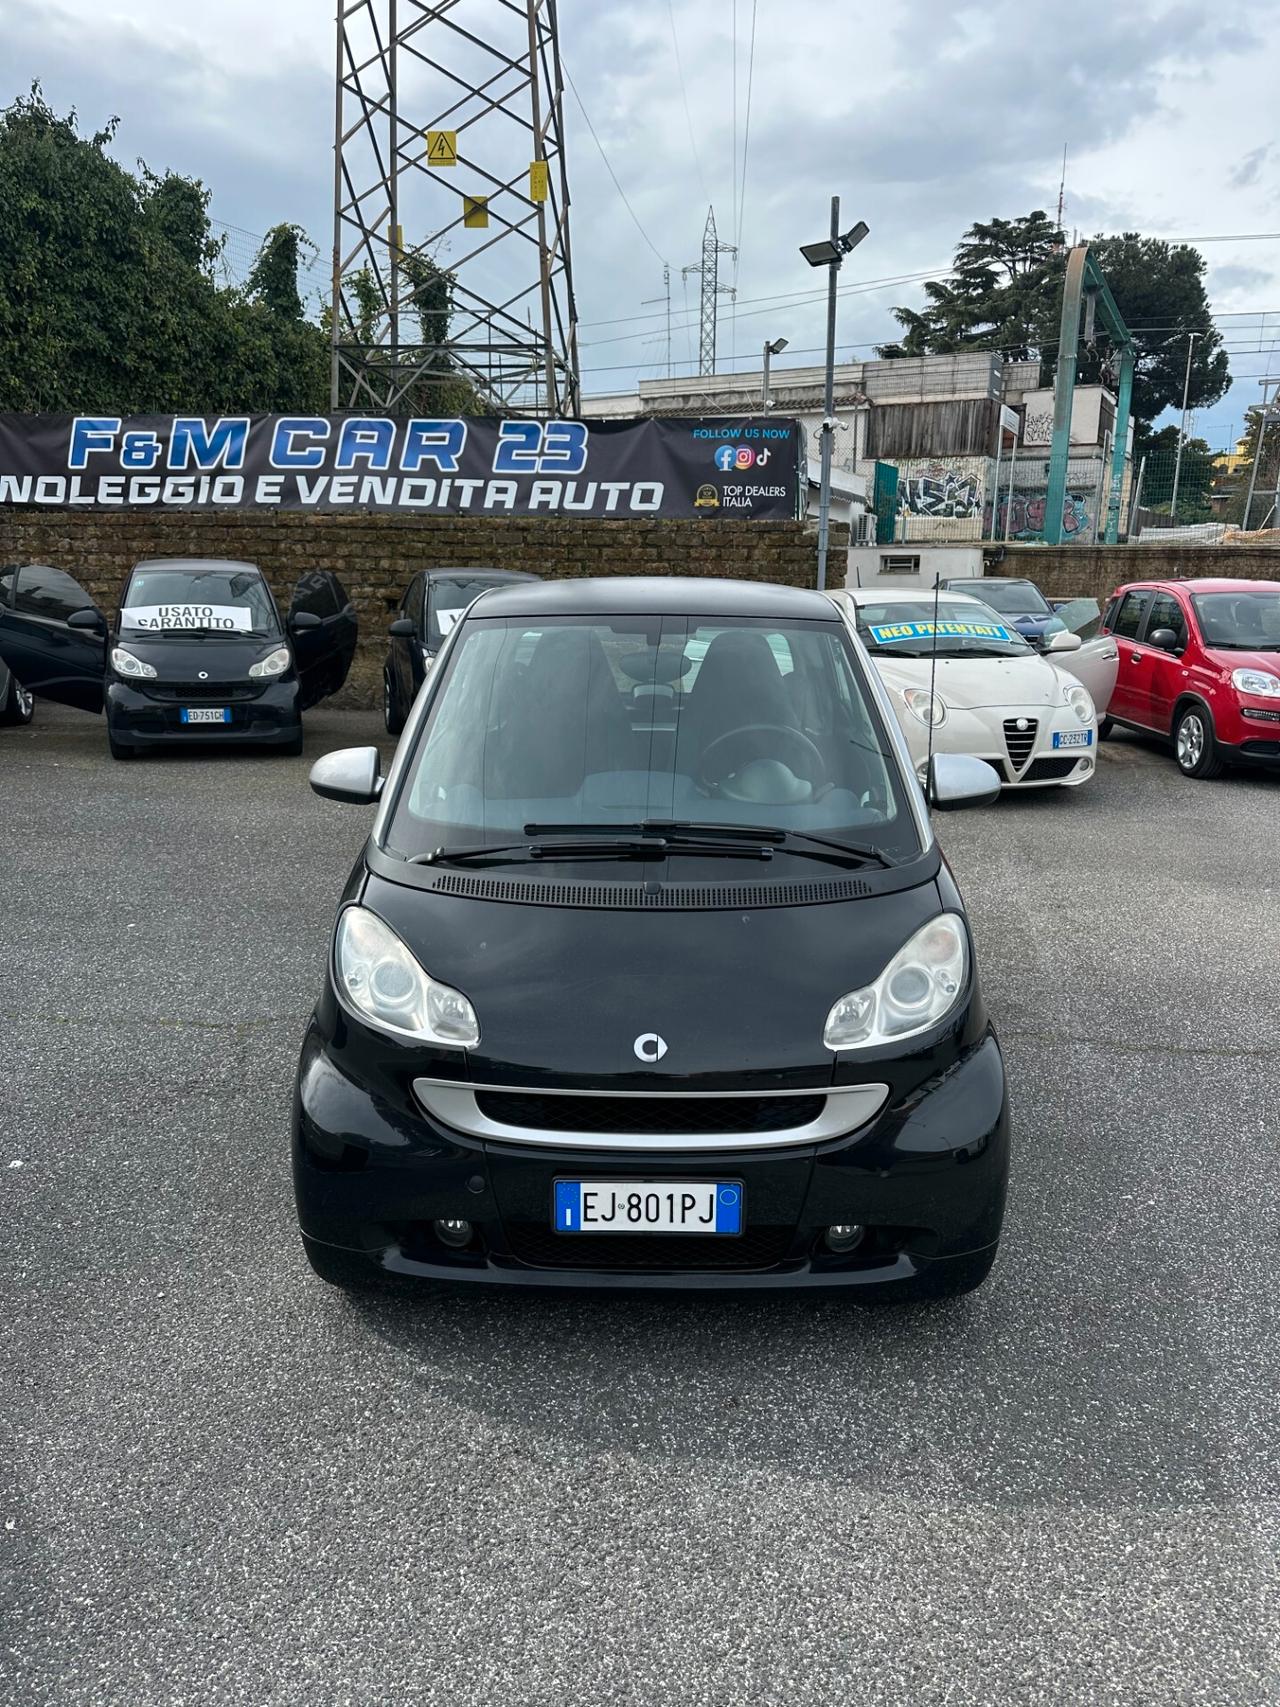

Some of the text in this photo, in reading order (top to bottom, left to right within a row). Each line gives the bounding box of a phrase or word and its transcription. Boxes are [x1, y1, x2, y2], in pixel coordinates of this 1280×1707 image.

[693, 429, 790, 439] FOLLOW US NOW
[68, 417, 588, 475] F&M CAR 23
[0, 475, 664, 511] NOLEGGIO E VENDITA AUTO
[722, 485, 786, 497] TOP DEALERS
[722, 496, 752, 507] ITALIA
[158, 606, 213, 618] USATO
[879, 623, 1003, 639] NEO PATENTATI
